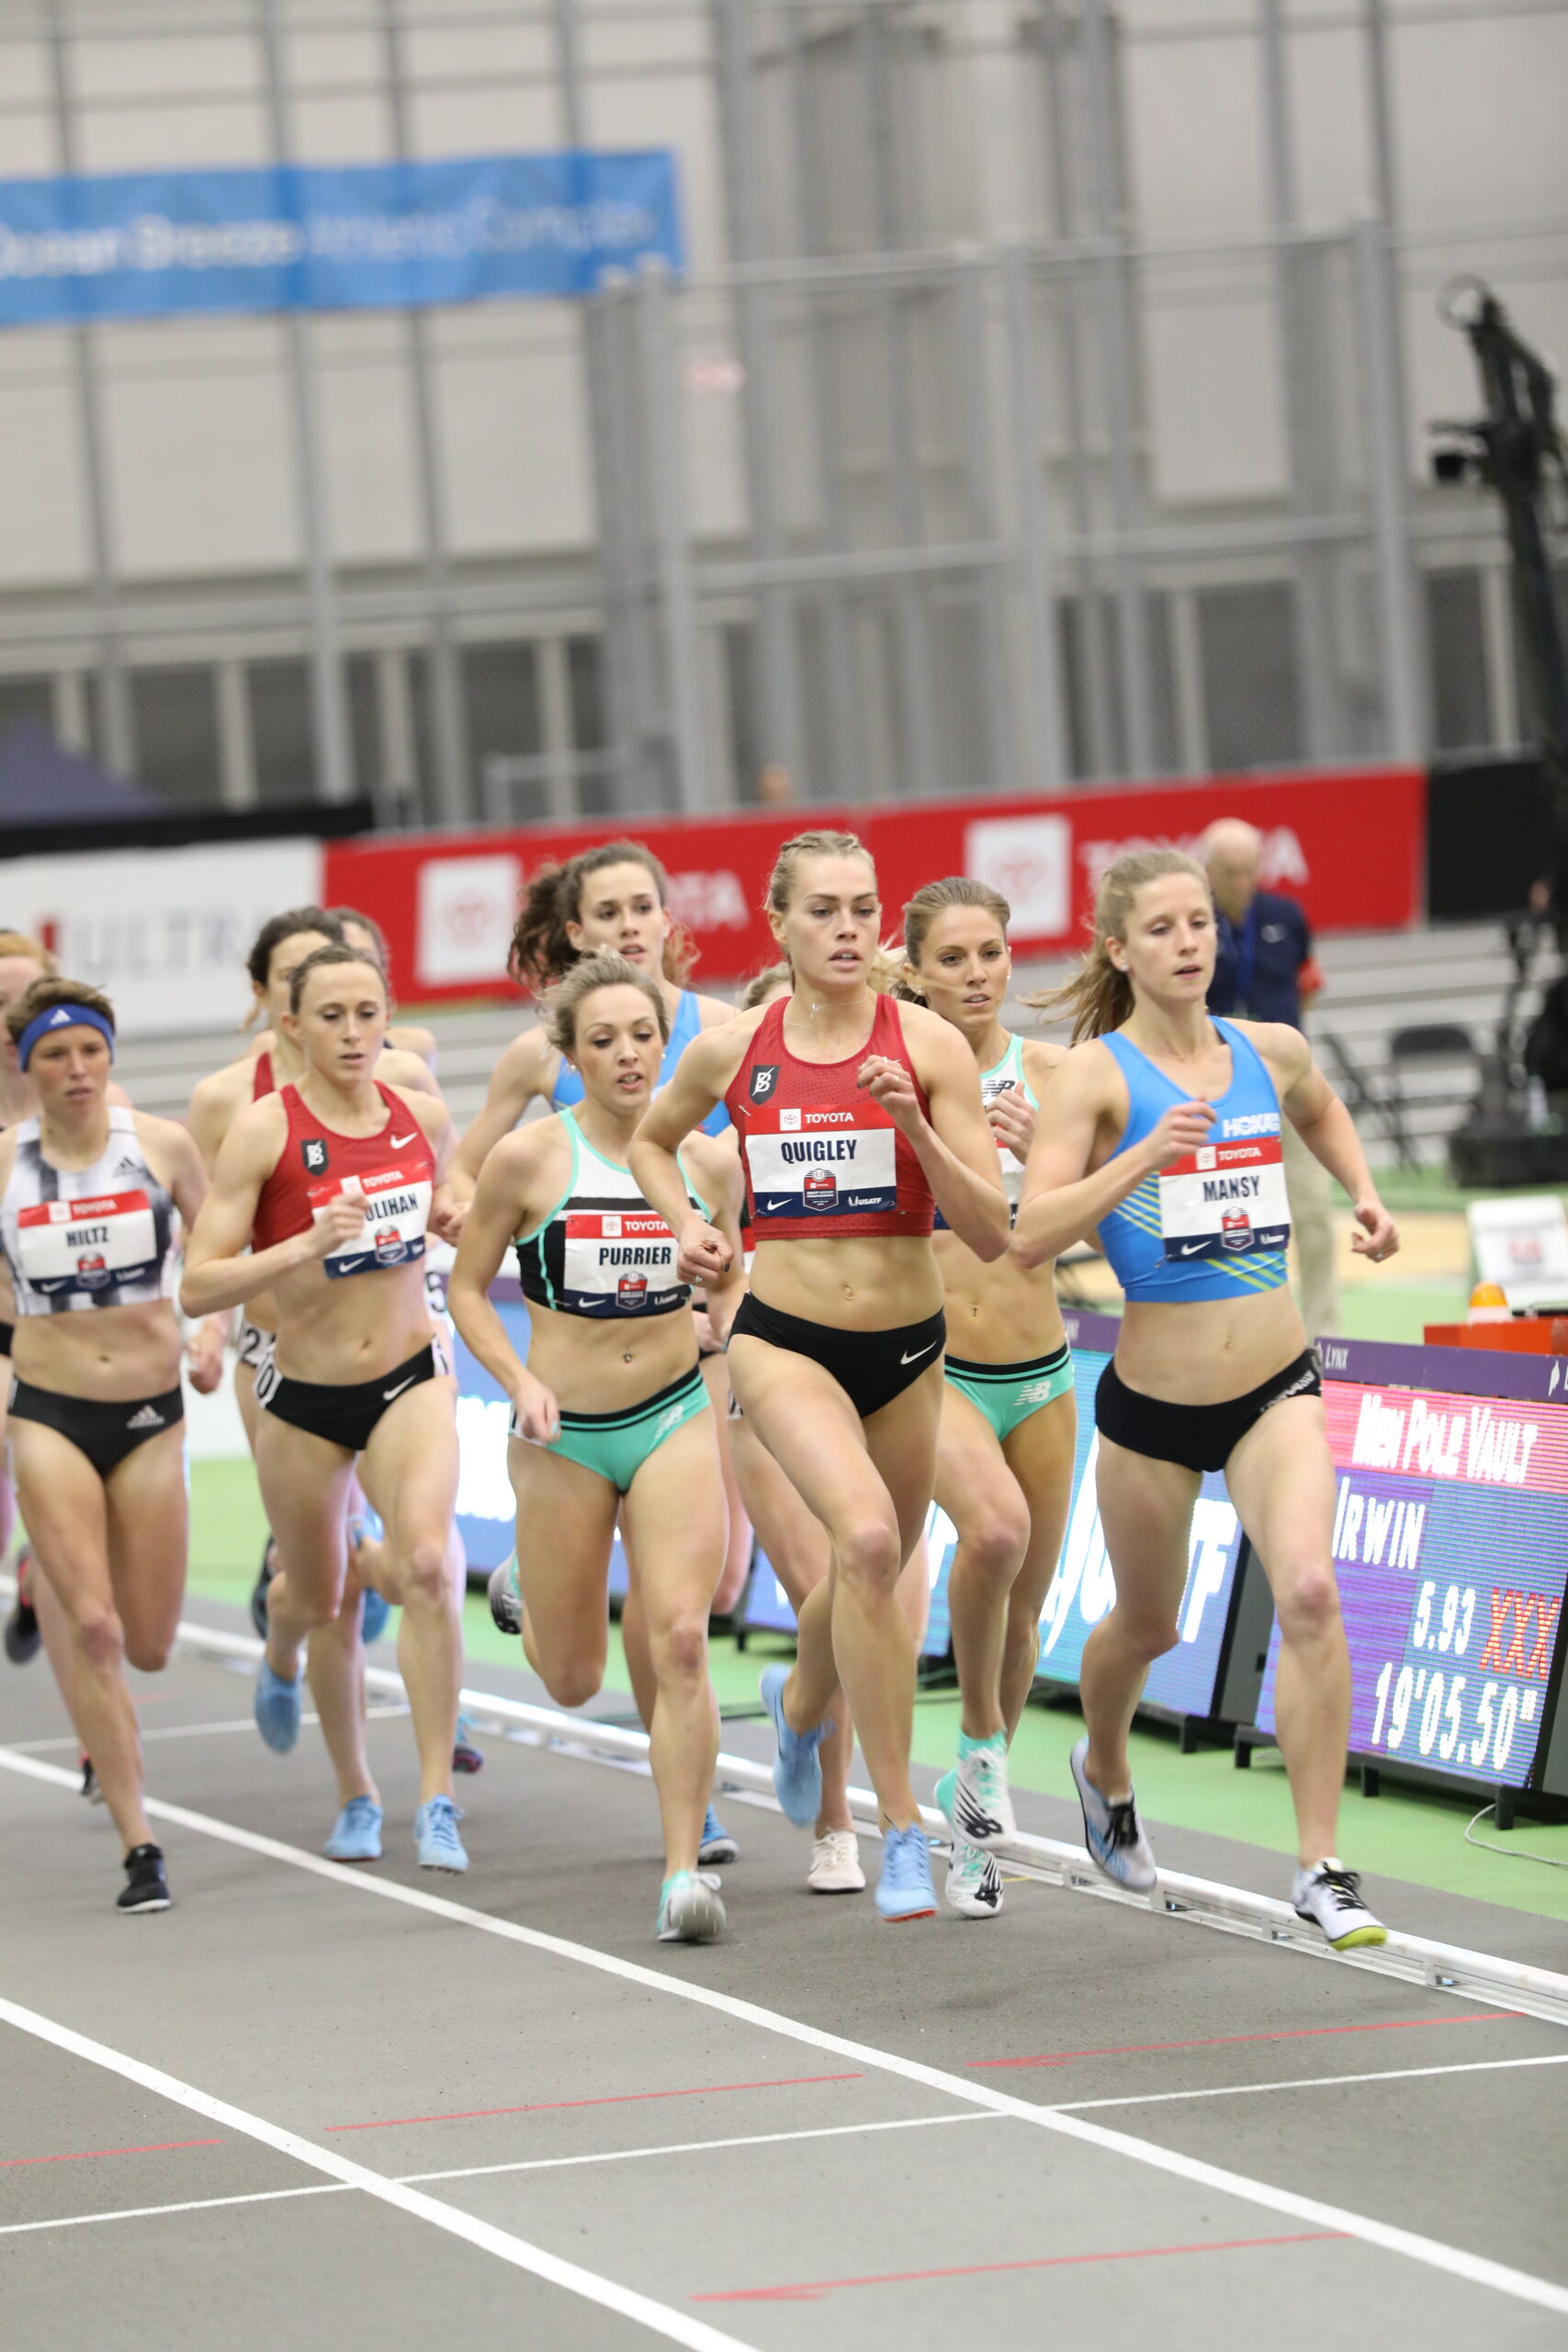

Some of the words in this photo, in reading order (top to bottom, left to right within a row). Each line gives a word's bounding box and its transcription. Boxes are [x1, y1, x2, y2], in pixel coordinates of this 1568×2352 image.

[805, 1112, 854, 1124] TOYOTA
[781, 1139, 857, 1164] QUIGLEY
[1217, 1148, 1262, 1161] TOYOTA
[362, 1170, 404, 1188] TOYOTA
[1202, 1175, 1260, 1202] MANSY
[73, 1199, 118, 1215] TOYOTA
[366, 1193, 419, 1222] ULIHAN
[625, 1220, 670, 1231] TOYOTA
[66, 1227, 109, 1247] HILTZ
[599, 1247, 672, 1266] PURRIER
[1402, 1399, 1466, 1476] POLE
[1467, 1407, 1539, 1484] VAULT
[1331, 1476, 1426, 1570] IRWIN
[1414, 1581, 1475, 1655] 5.93
[1479, 1588, 1560, 1680] XXX
